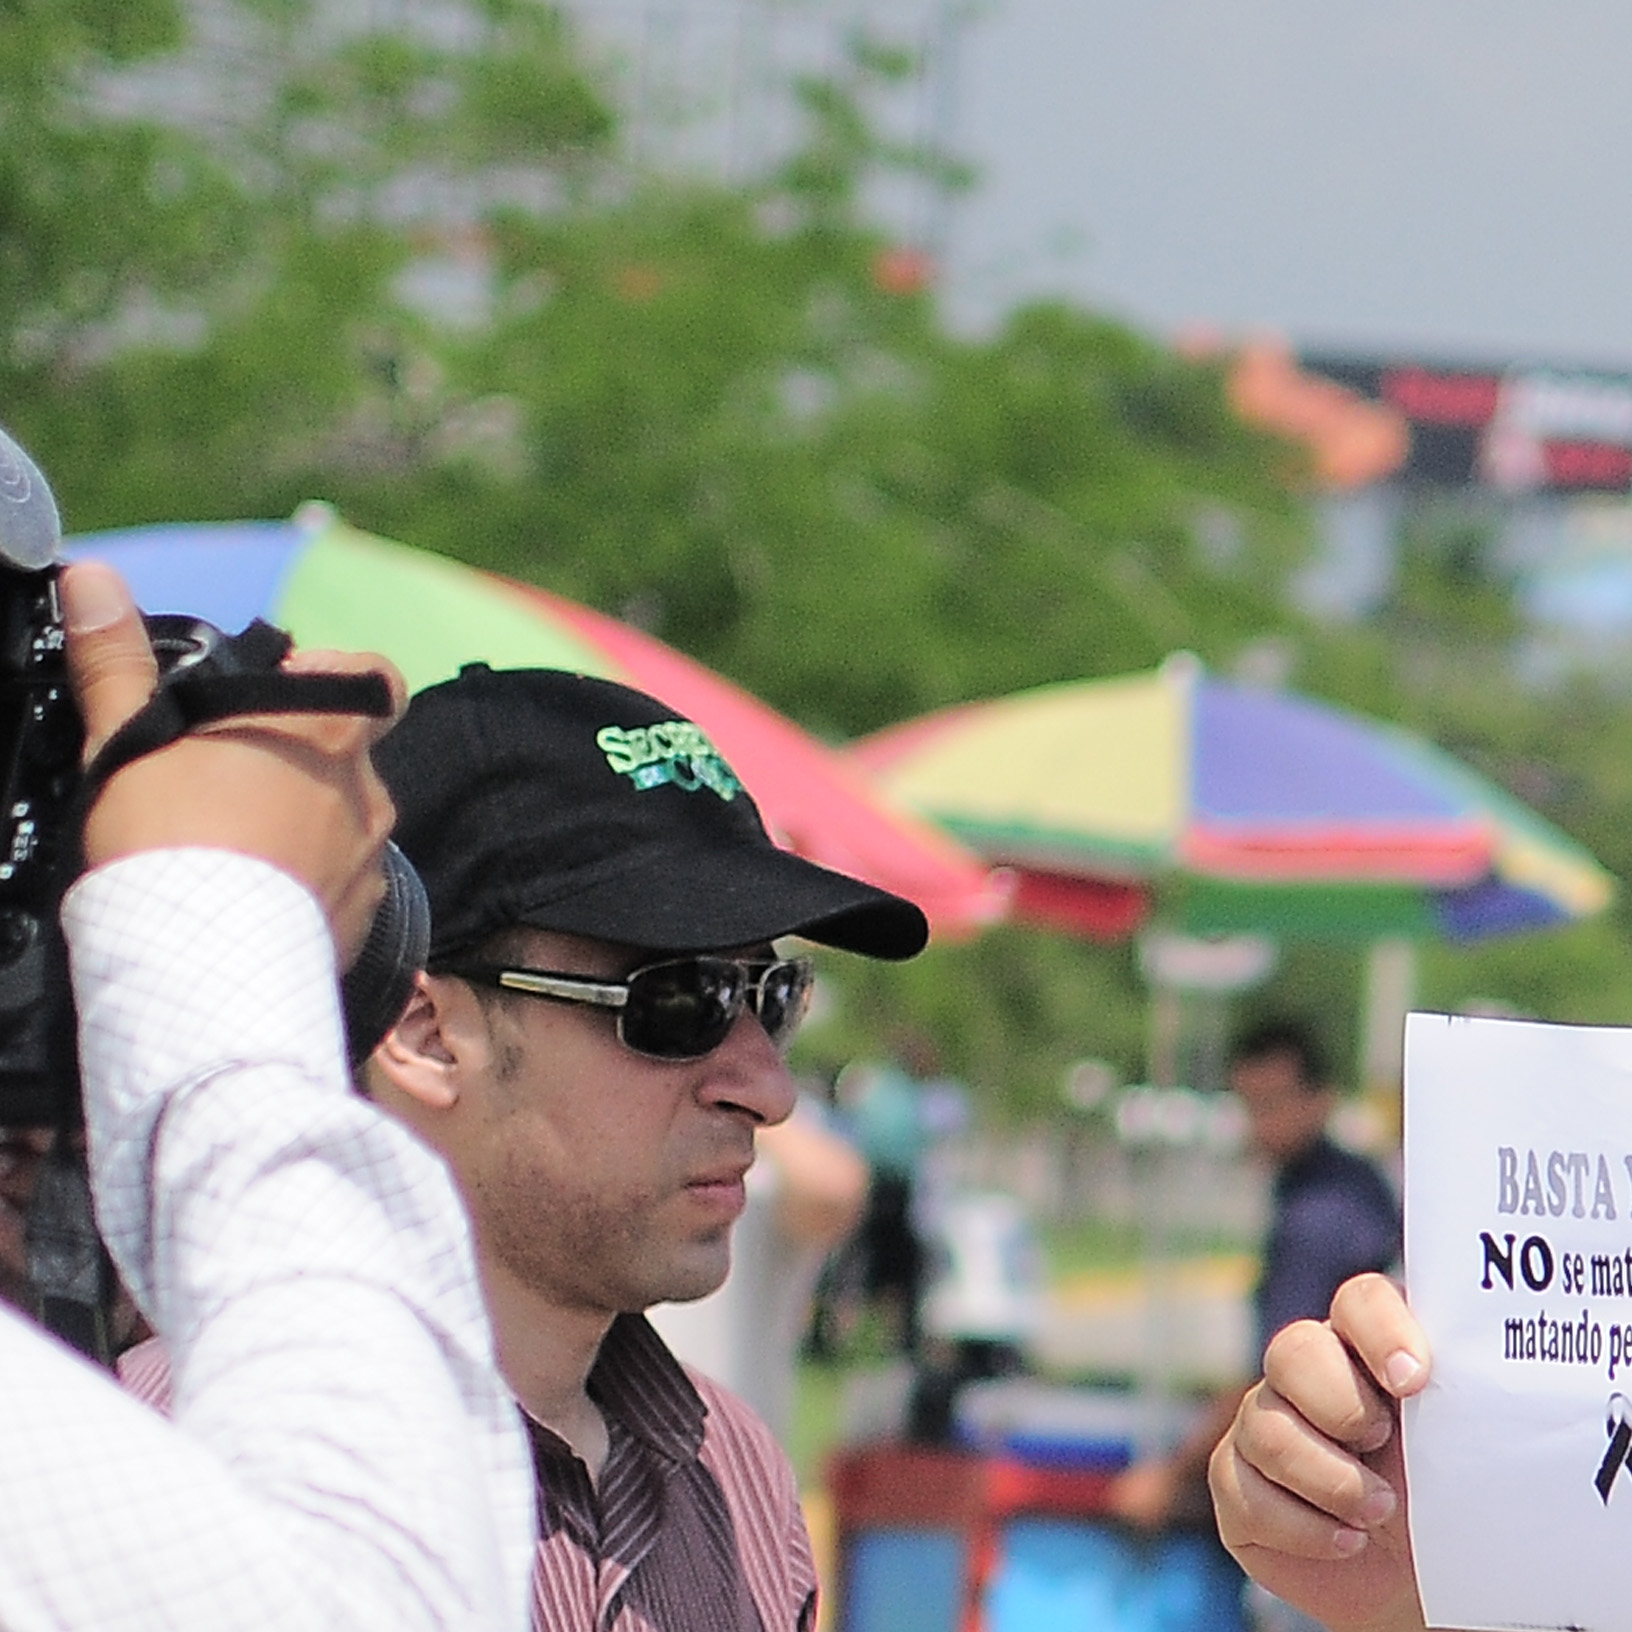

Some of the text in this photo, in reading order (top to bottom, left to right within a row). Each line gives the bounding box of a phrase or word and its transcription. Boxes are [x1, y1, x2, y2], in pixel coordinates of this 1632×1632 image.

[1498, 1146, 1616, 1221] BASTA
[1479, 1231, 1555, 1292] NO
[1562, 1252, 1585, 1295] se
[1504, 1308, 1602, 1365] matando
